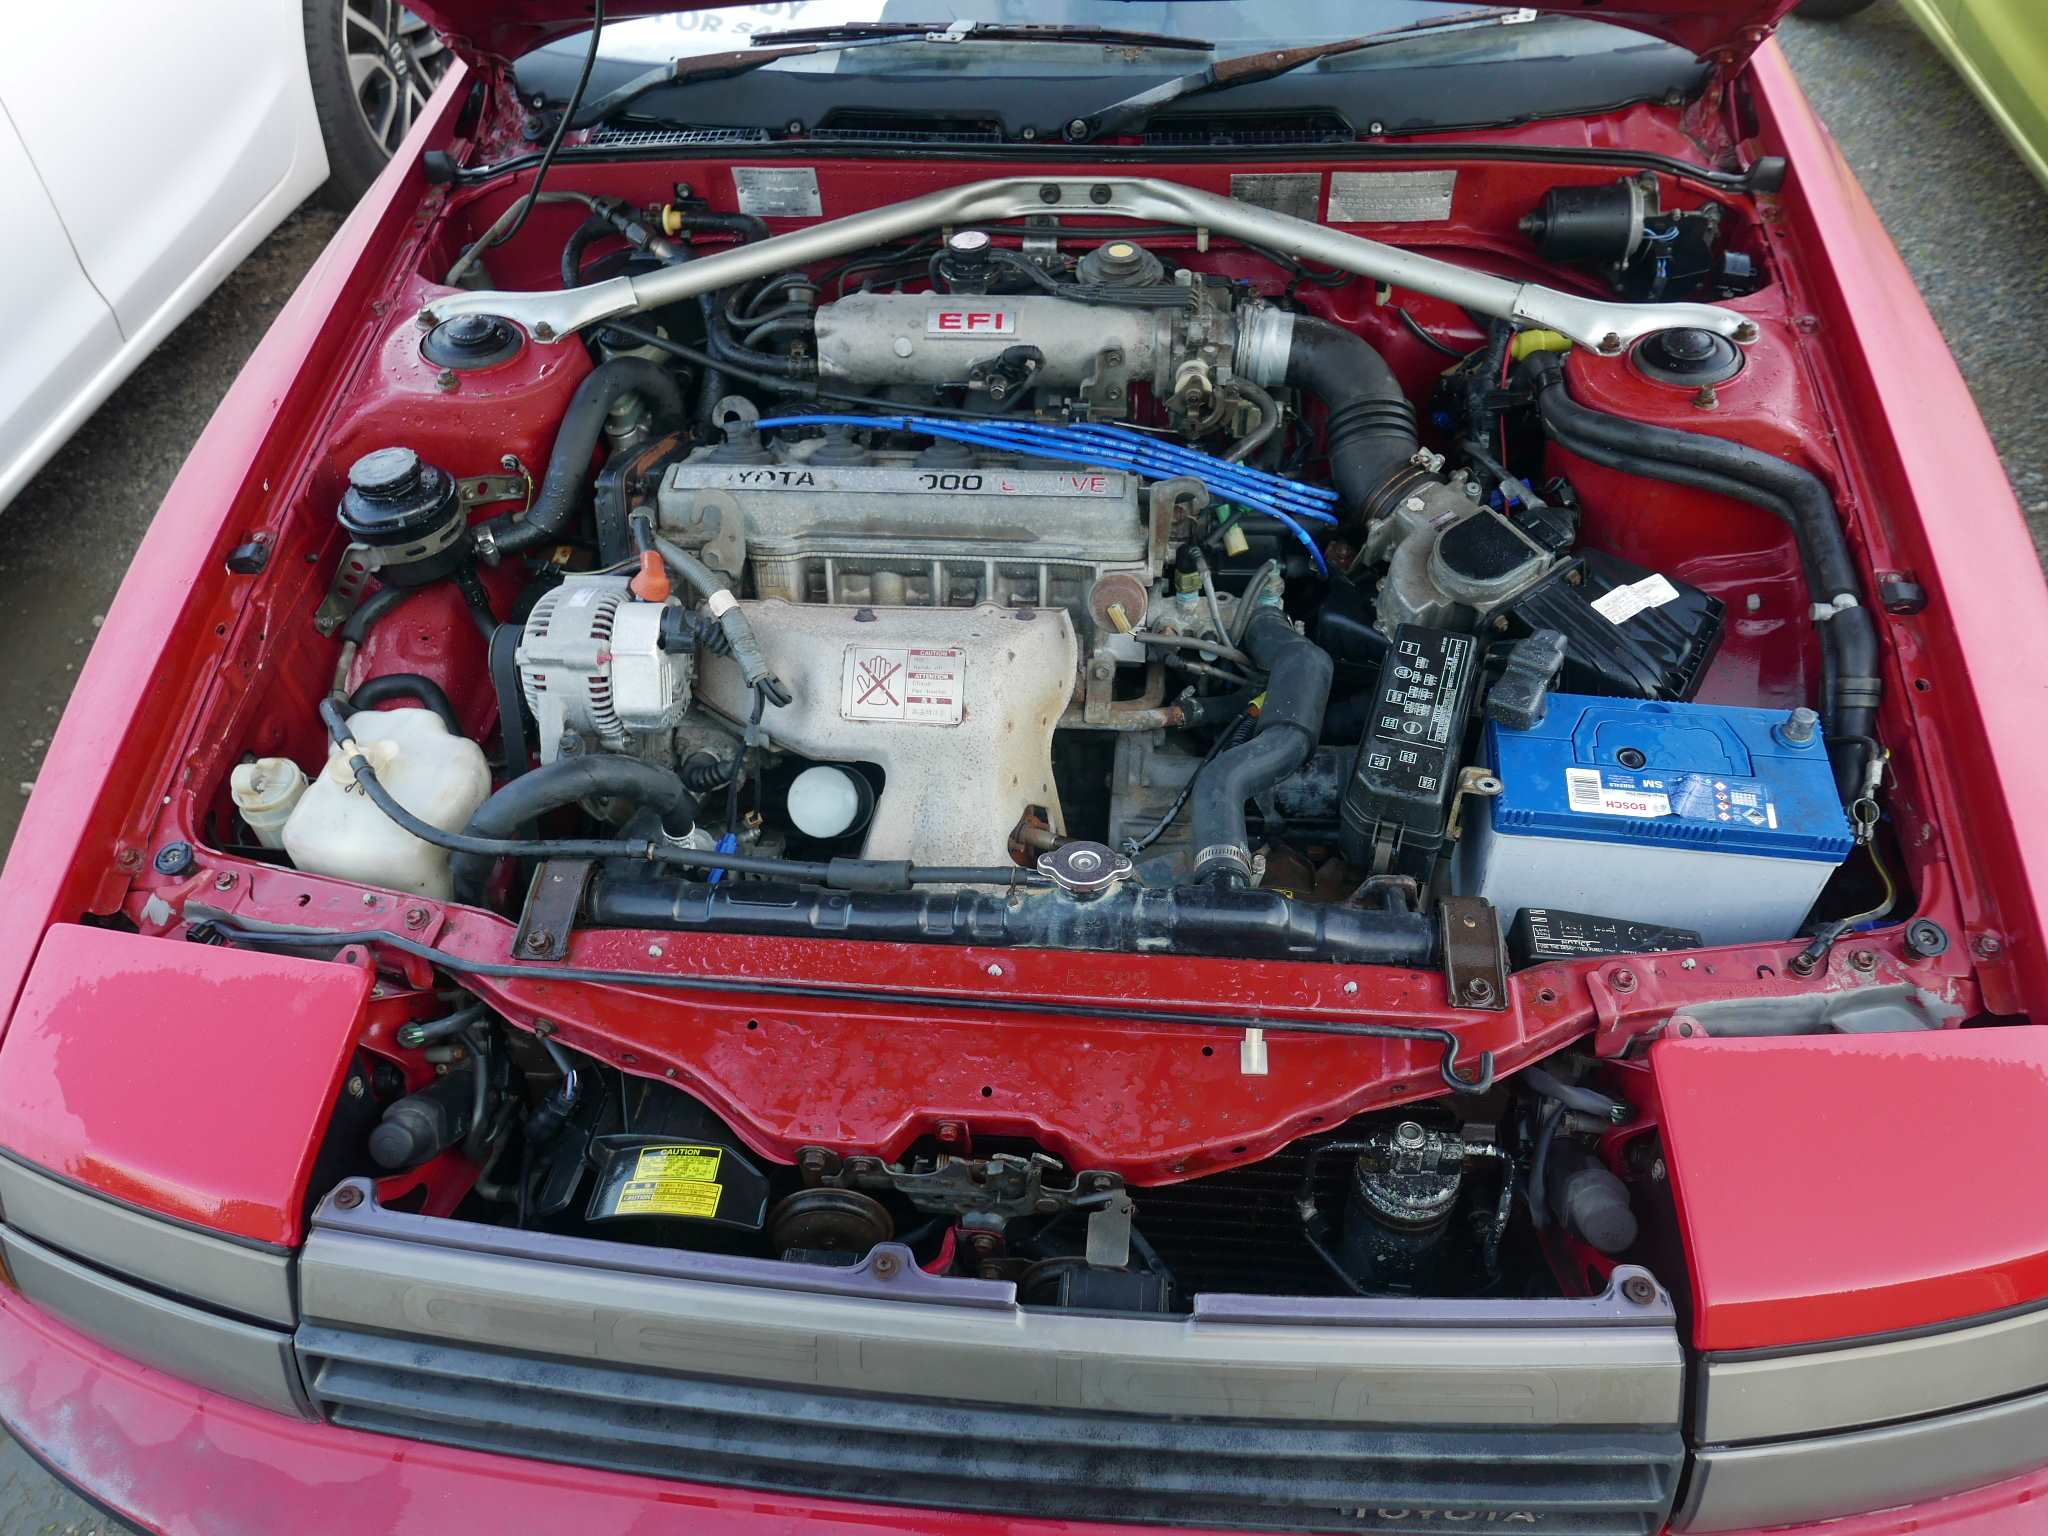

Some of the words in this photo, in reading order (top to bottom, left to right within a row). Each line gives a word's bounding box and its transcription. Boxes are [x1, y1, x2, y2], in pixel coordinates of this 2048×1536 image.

[939, 313, 1004, 330] EFI
[1642, 779, 1665, 789] SM
[1605, 800, 1648, 811] BOSCH
[660, 1148, 701, 1156] CAUTION
